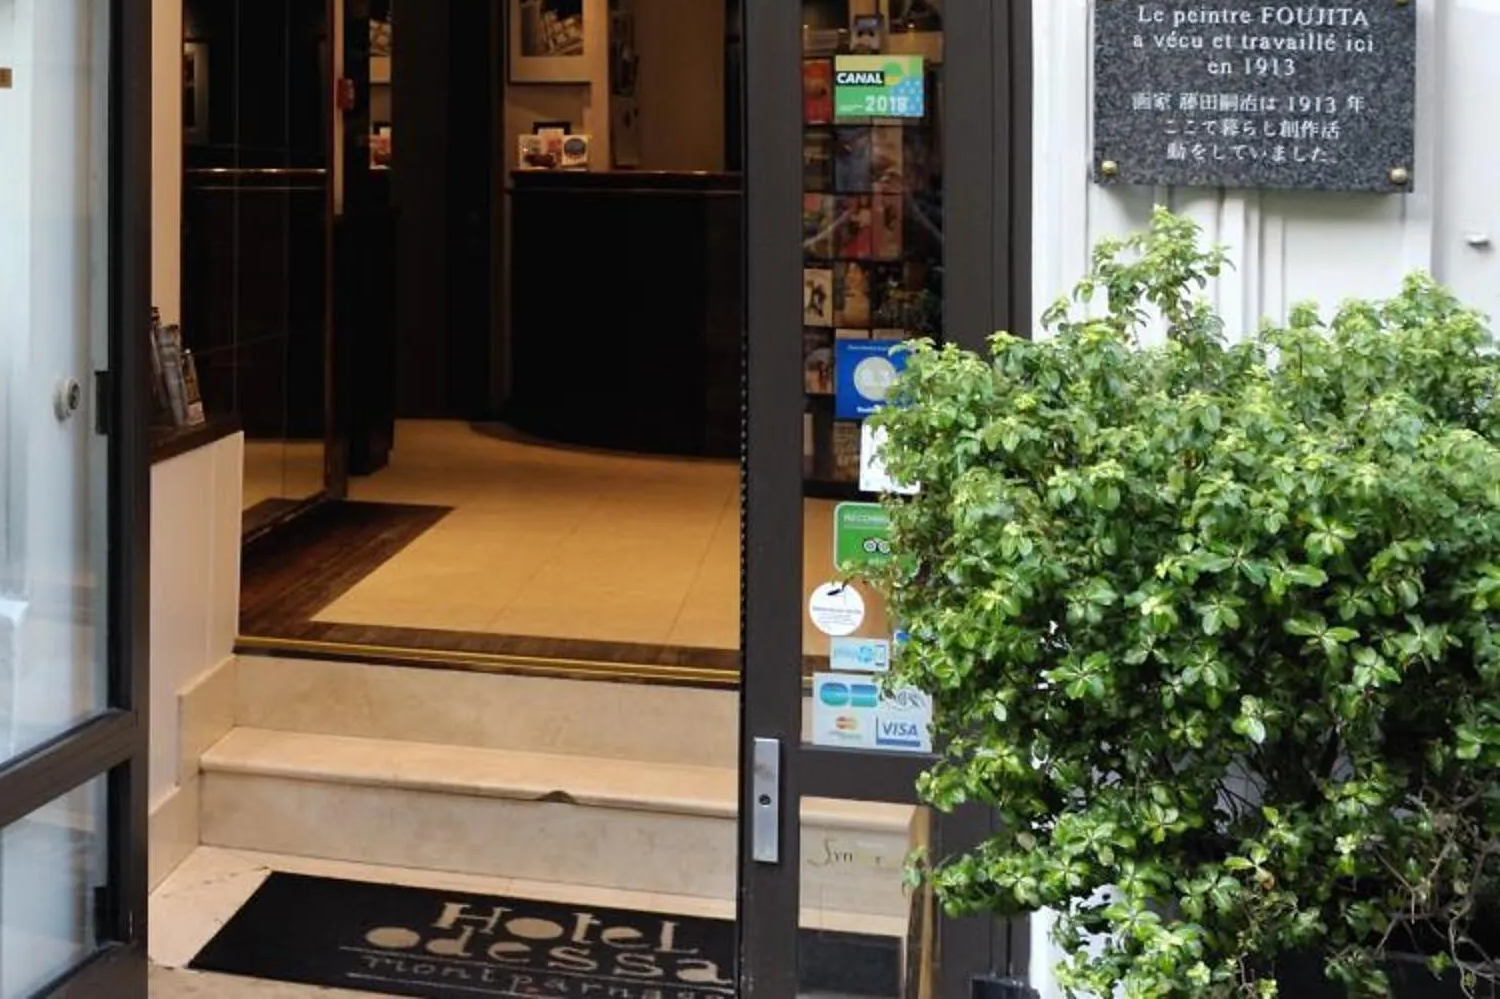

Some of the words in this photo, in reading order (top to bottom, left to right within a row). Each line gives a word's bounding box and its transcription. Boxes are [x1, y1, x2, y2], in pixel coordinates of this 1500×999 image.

[1137, 5, 1164, 23] Le
[1173, 6, 1251, 27] peintre
[1261, 6, 1369, 26] FOUJITA
[1133, 35, 1143, 48] a
[1153, 30, 1203, 49] vécu
[1212, 34, 1232, 49] et
[1242, 32, 1337, 51] travaillé
[1346, 34, 1374, 52] ici
[1207, 60, 1232, 74] en
[1244, 58, 1296, 76] 1913
[837, 72, 883, 84] CANAL
[883, 721, 918, 736] VISA
